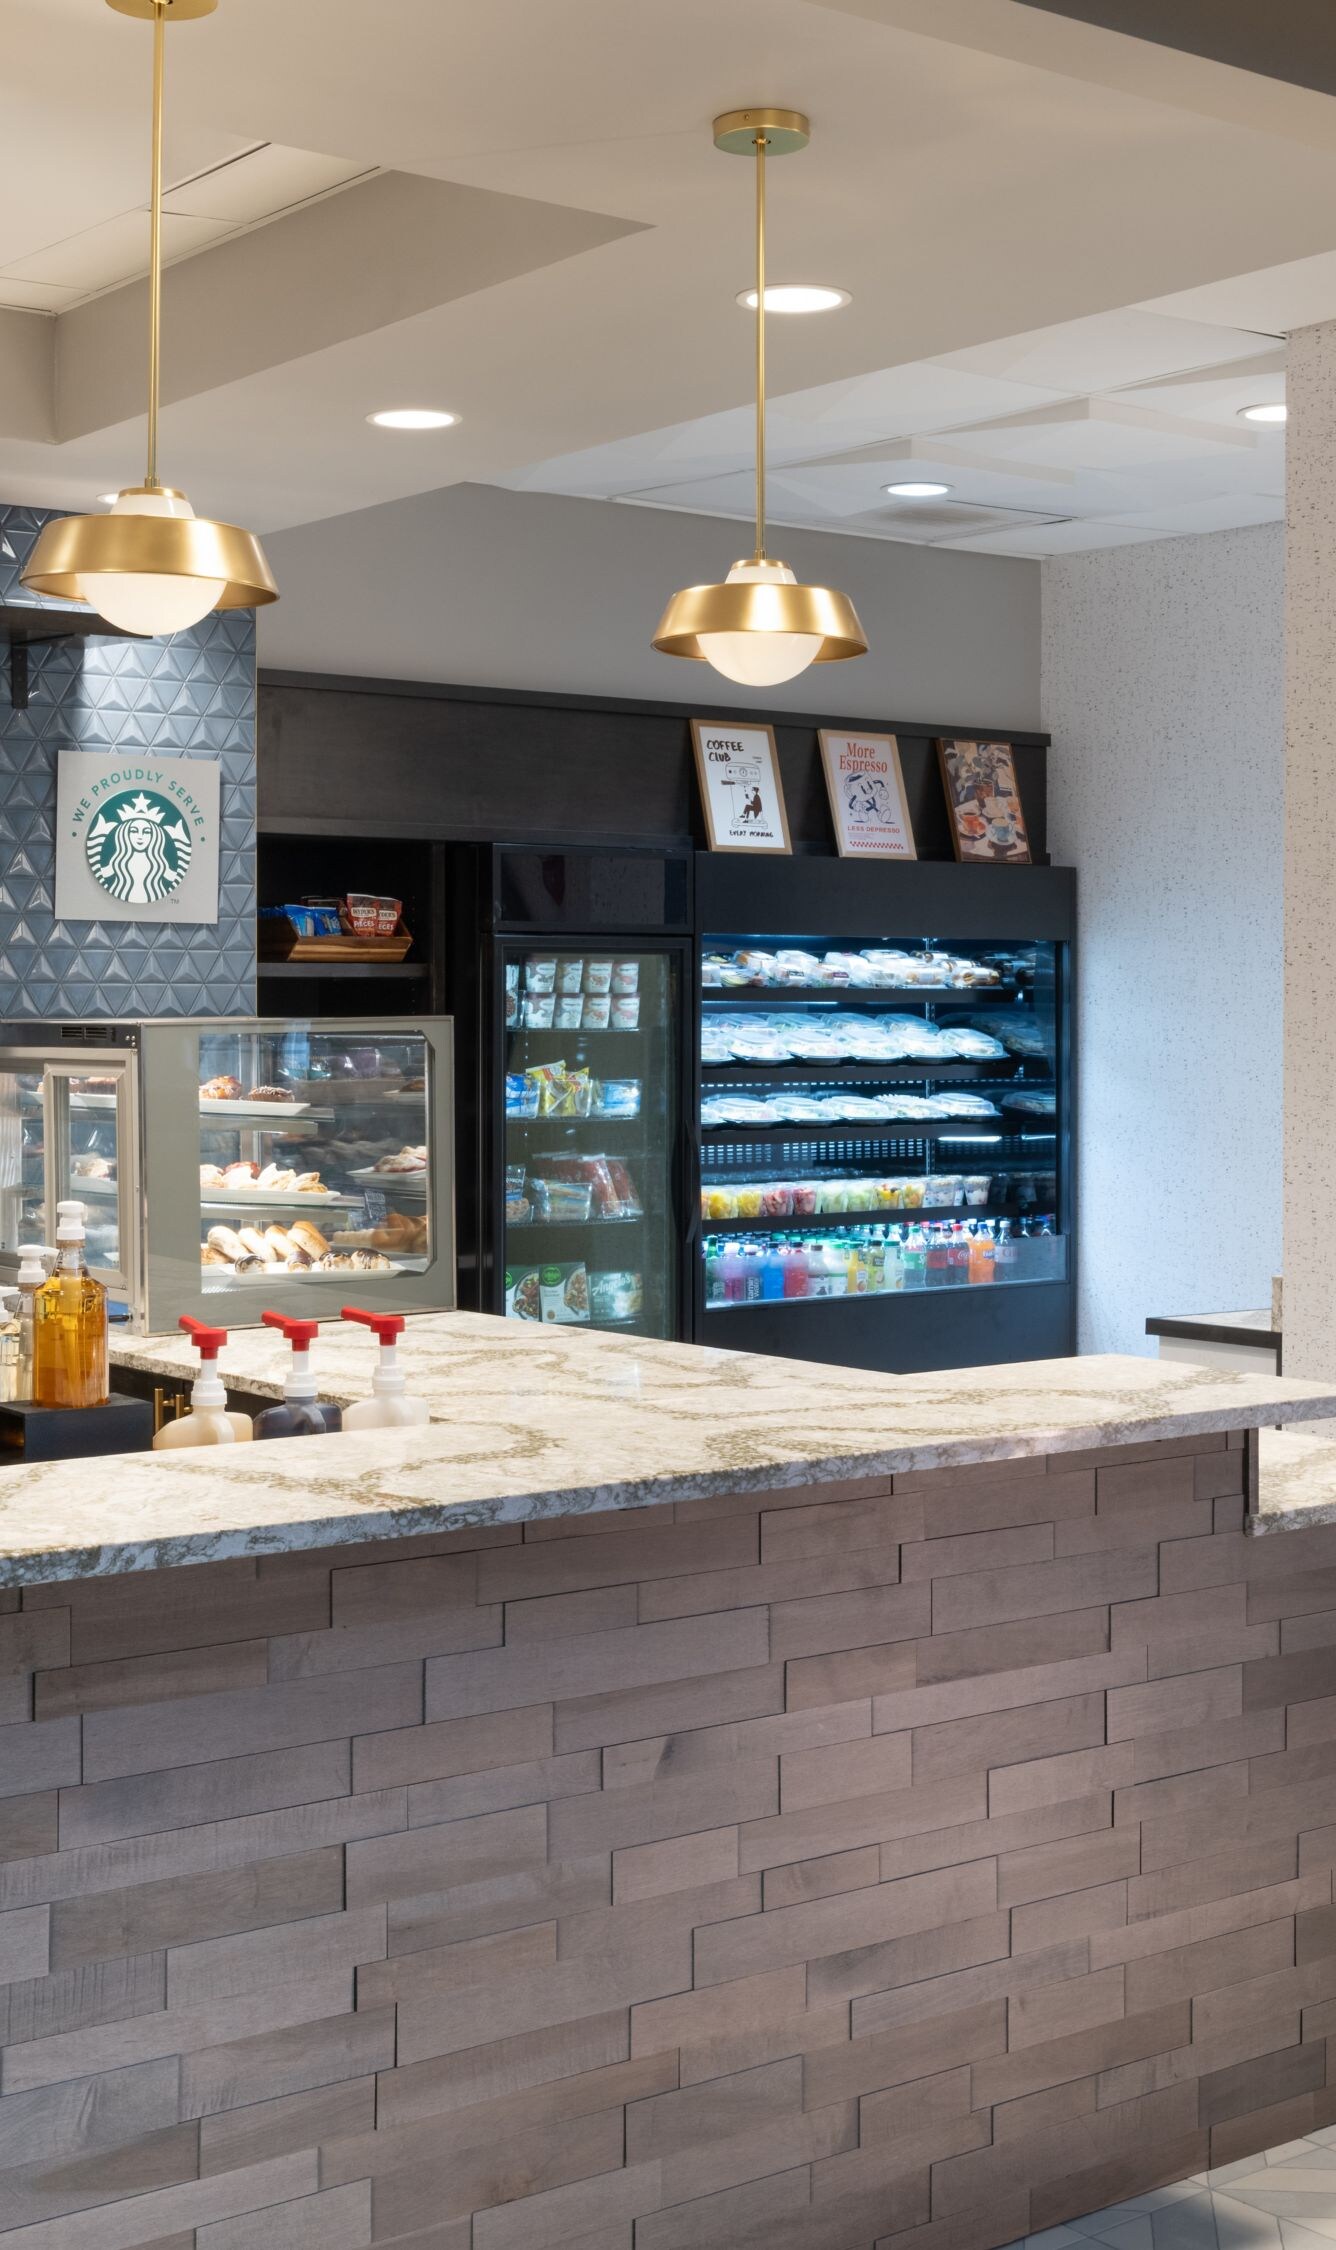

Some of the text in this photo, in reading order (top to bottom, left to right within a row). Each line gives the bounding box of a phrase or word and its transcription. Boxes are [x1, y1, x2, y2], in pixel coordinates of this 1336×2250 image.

[706, 739, 745, 752] COFFEE
[846, 742, 875, 758] More
[708, 751, 732, 763] CLUB
[839, 754, 888, 773] Espresso
[72, 768, 205, 827] WE PROUDLY SERVE
